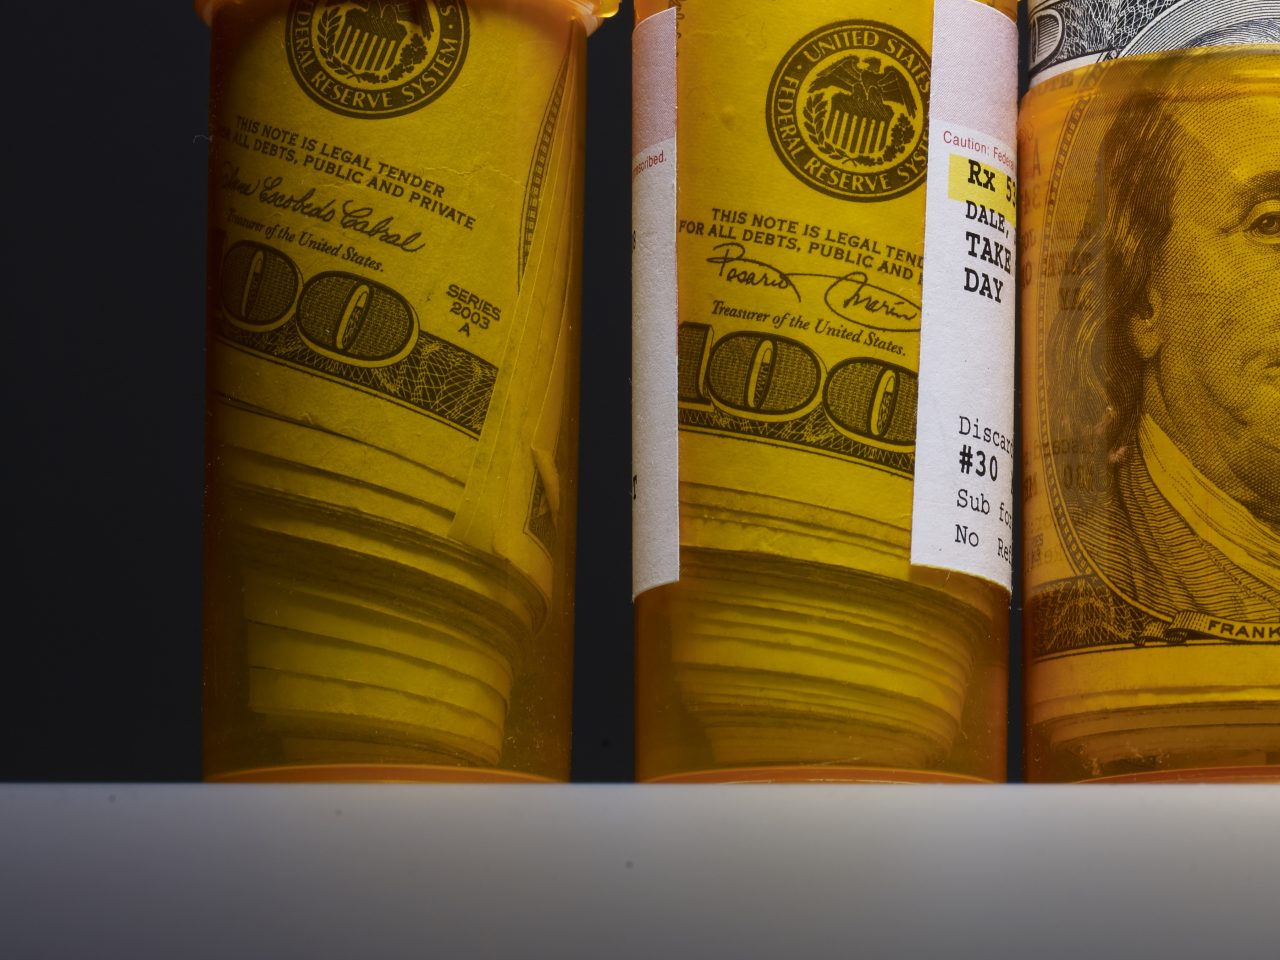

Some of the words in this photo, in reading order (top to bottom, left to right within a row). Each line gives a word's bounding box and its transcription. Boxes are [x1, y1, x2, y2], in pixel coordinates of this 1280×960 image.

[311, 71, 393, 109] RESERVE
[402, 38, 458, 103] SYSTEM
[803, 30, 880, 63] UNITED
[885, 38, 931, 92] STATES
[777, 75, 805, 159] FEDERAL
[804, 157, 893, 191] RESERVE
[943, 130, 990, 156] Caution:
[993, 147, 1016, 170] Federa
[237, 115, 259, 134] THIS
[262, 123, 299, 146] NOTE
[301, 137, 317, 152] IS
[320, 143, 372, 171] LEGAL
[378, 161, 446, 198] TENDER
[968, 159, 996, 193] Rx
[253, 139, 298, 164] DEBTS,
[303, 155, 362, 184] PUBLIC
[367, 176, 404, 198] AND
[408, 191, 477, 230] PRIVATE
[711, 208, 747, 224] THIS
[751, 213, 799, 235] NOTE
[802, 225, 820, 238] IS
[825, 229, 881, 255] LEGAL
[885, 245, 924, 268] TEND
[966, 200, 1009, 238] DALE,
[265, 224, 277, 239] of
[278, 224, 295, 242] the
[298, 231, 340, 257] United
[342, 246, 384, 273] States.
[678, 219, 704, 235] FOR
[708, 224, 736, 240] ALL
[742, 229, 801, 252] DEBTS,
[808, 243, 874, 268] PUBLIC
[876, 260, 914, 281] AND
[966, 231, 1012, 274] TAKE
[446, 284, 502, 322] SERIES
[964, 267, 1004, 303] DAY
[449, 301, 491, 331] 2003
[458, 322, 472, 338] A
[711, 299, 770, 321] Treasurer
[772, 312, 791, 329] of
[790, 313, 810, 330] the
[815, 319, 861, 344] United
[864, 332, 906, 356] States.
[959, 416, 1014, 458] Discar
[959, 444, 998, 481] #30
[957, 489, 990, 515] Sub
[954, 524, 980, 547] No
